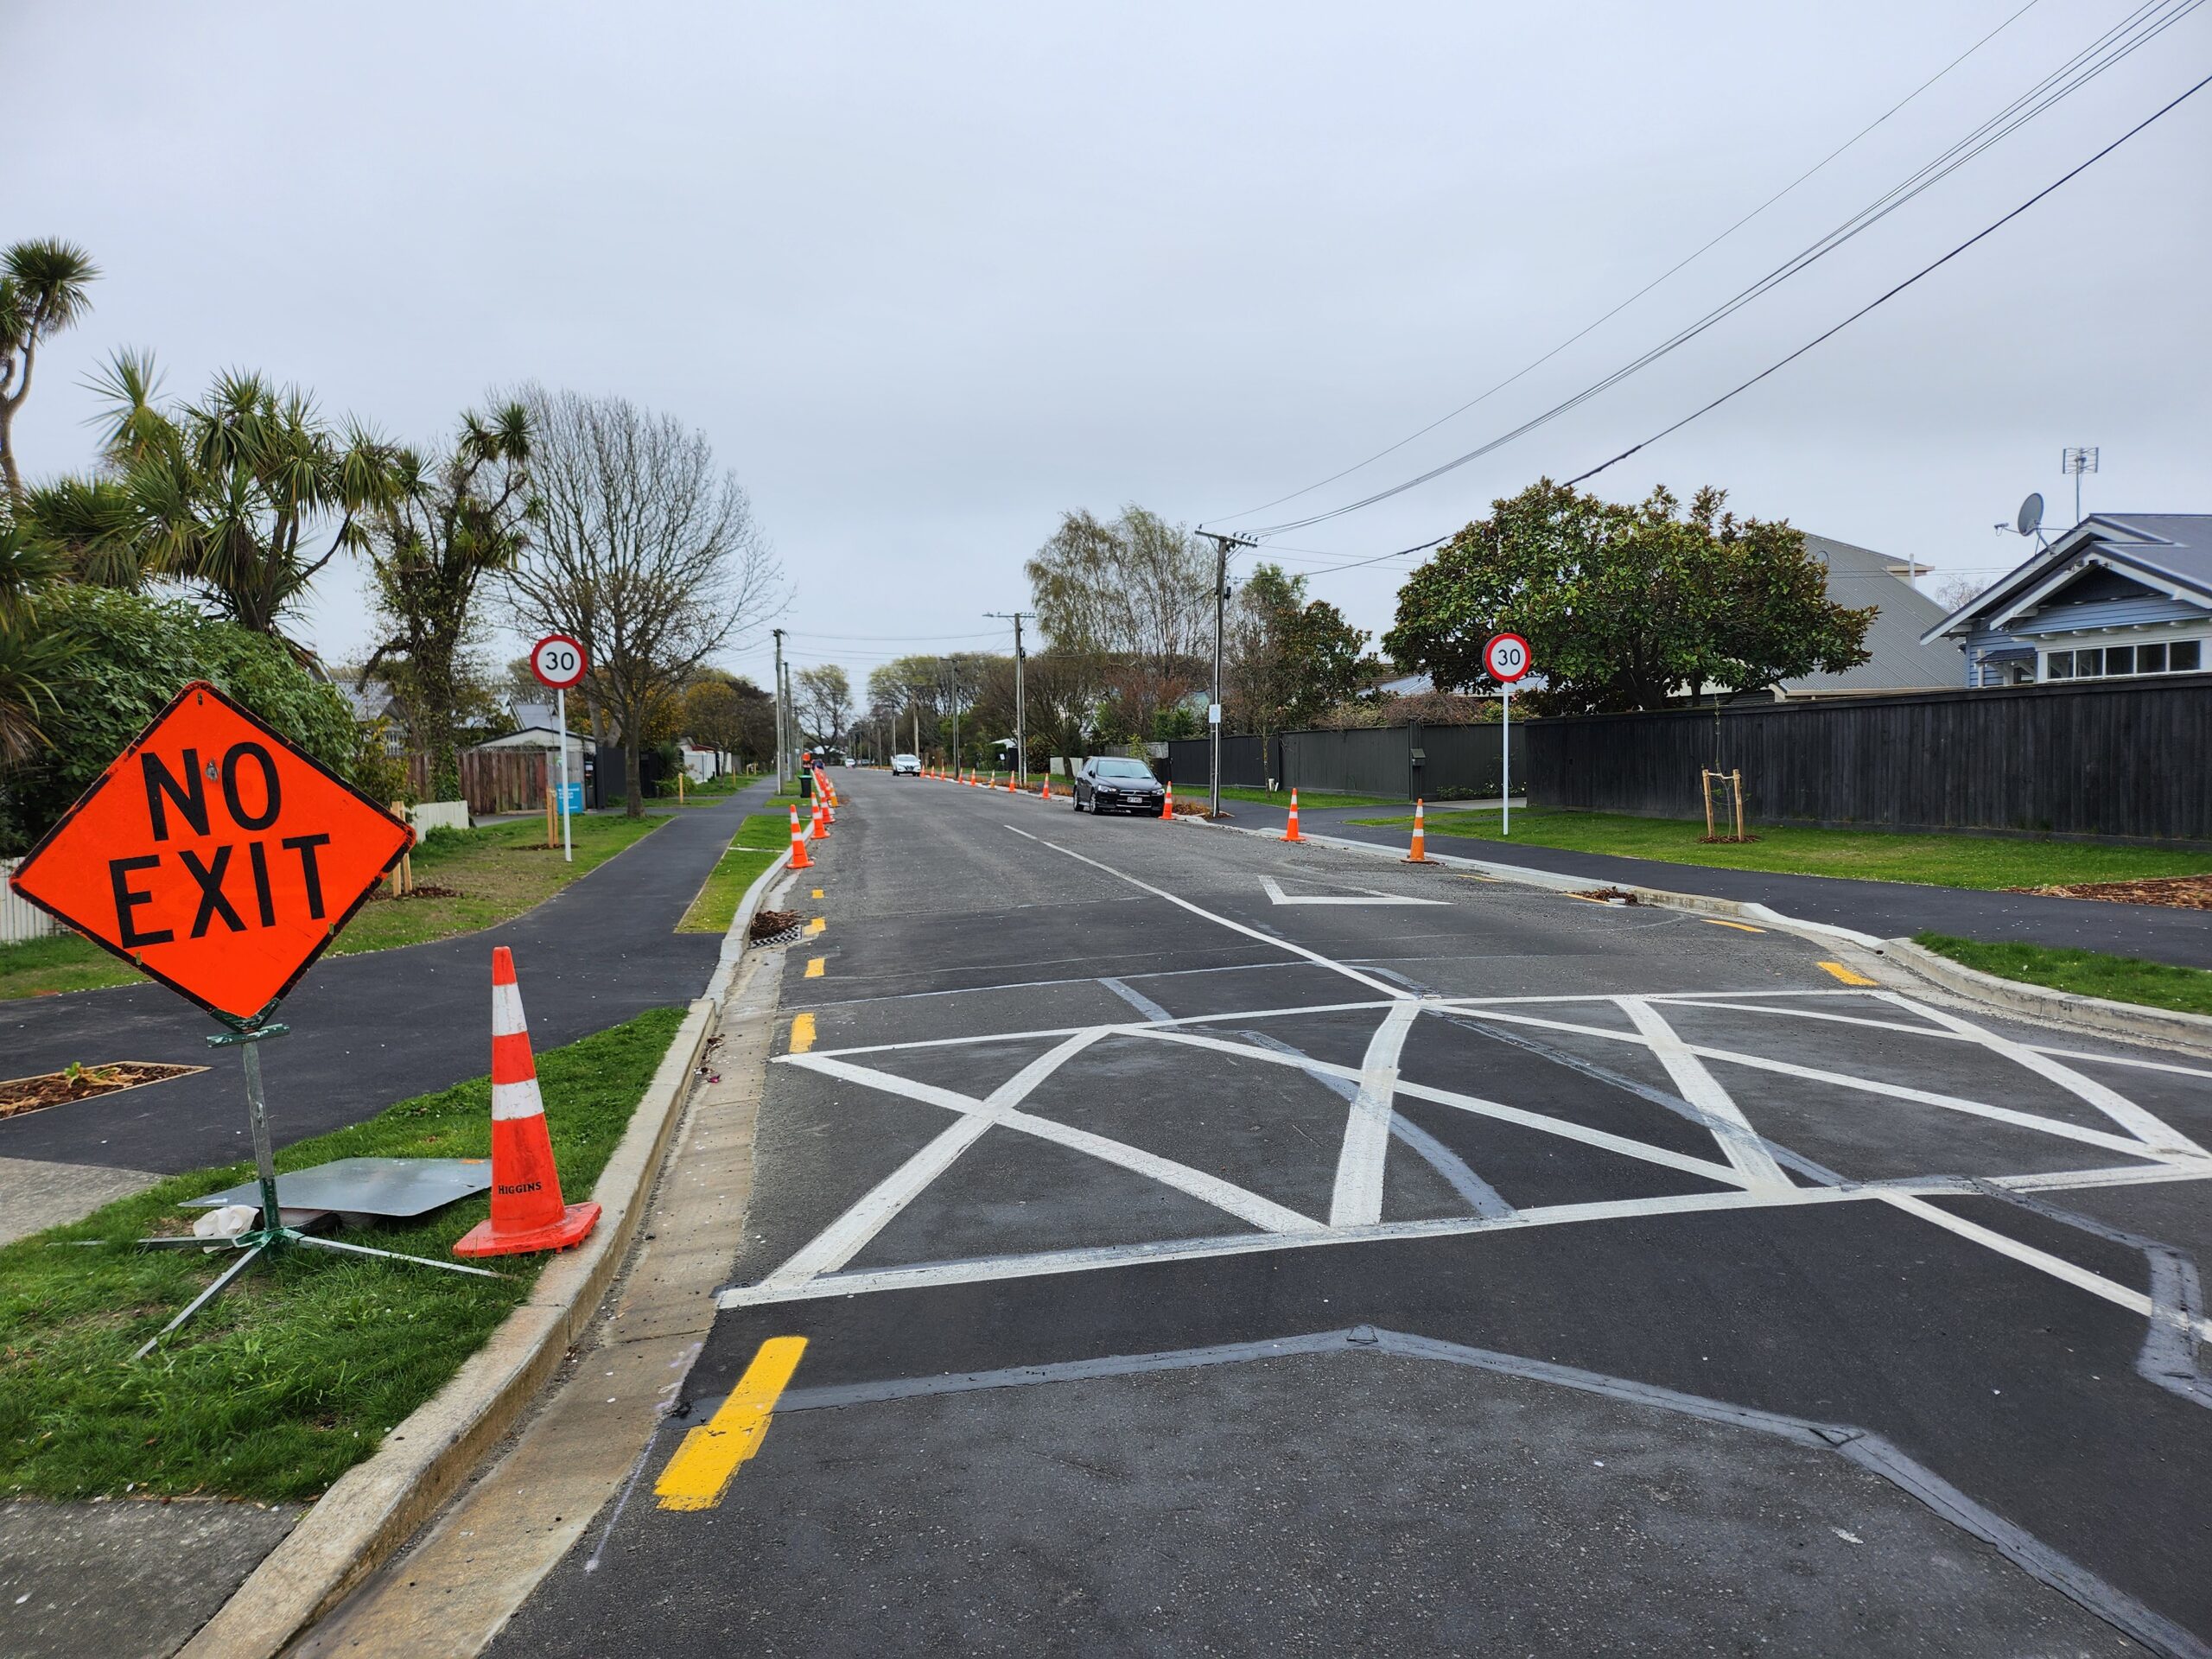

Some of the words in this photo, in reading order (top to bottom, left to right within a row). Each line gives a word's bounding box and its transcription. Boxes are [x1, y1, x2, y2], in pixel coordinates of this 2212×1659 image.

[545, 652, 575, 671] 30
[1497, 648, 1521, 666] 30
[141, 741, 282, 842] NO
[109, 833, 331, 949] EXIT
[498, 1181, 542, 1194] HIGGINS
